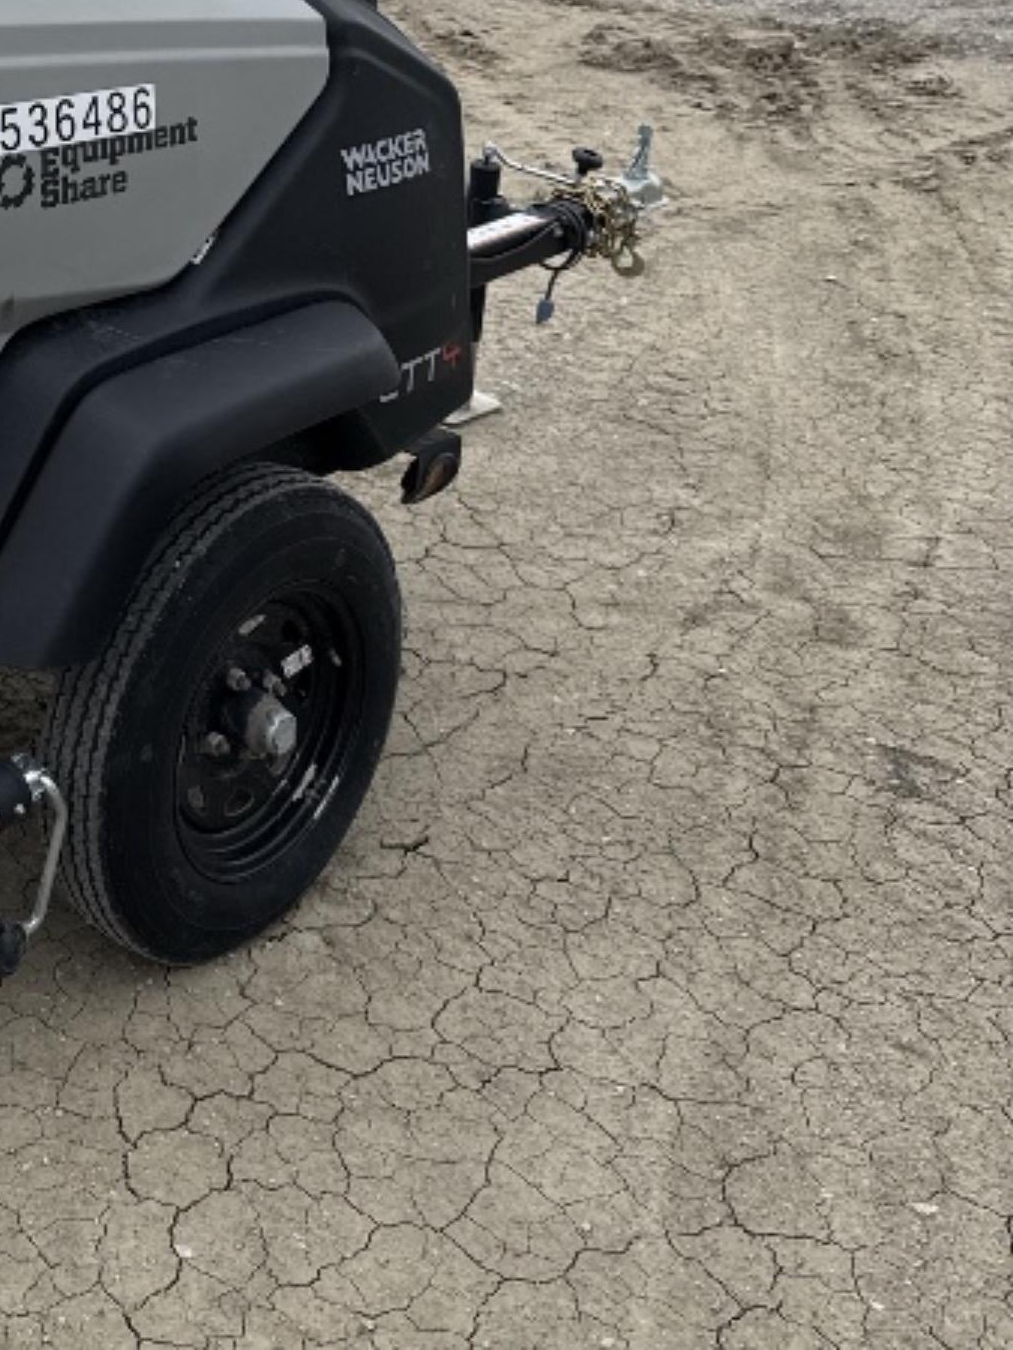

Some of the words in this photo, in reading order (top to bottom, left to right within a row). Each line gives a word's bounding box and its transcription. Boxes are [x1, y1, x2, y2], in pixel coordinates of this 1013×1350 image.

[0, 86, 151, 151] 536486
[340, 128, 427, 172] WACKER
[40, 169, 128, 208] Share
[346, 151, 430, 196] NEUSON
[380, 342, 461, 403] TT4
